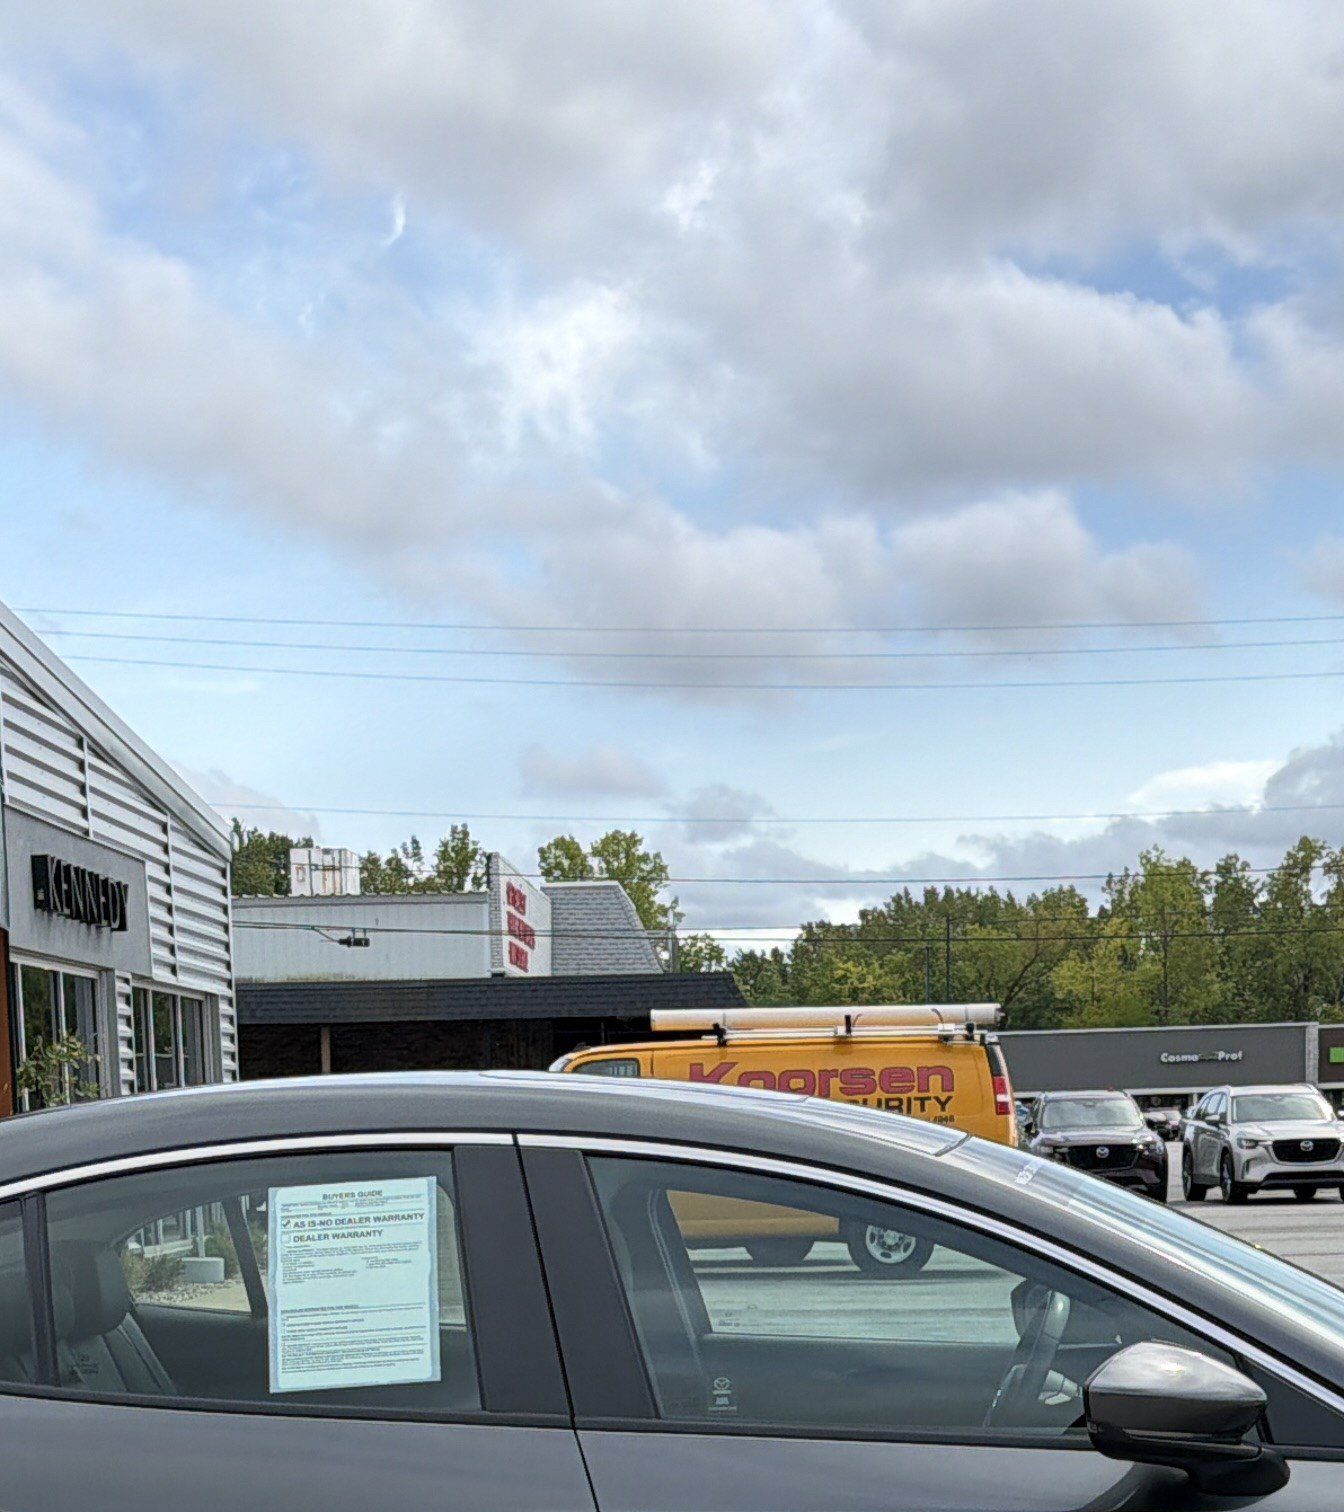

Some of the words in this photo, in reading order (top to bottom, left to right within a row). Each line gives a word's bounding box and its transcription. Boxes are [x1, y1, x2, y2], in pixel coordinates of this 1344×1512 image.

[34, 854, 129, 930] KENNEDY
[357, 1189, 383, 1199] GUIDE
[293, 1220, 306, 1229] AS
[334, 1216, 371, 1226] DEALER
[372, 1212, 425, 1223] WARRANTY
[292, 1233, 330, 1243] DEALER
[331, 1229, 384, 1241] WARRANTY
